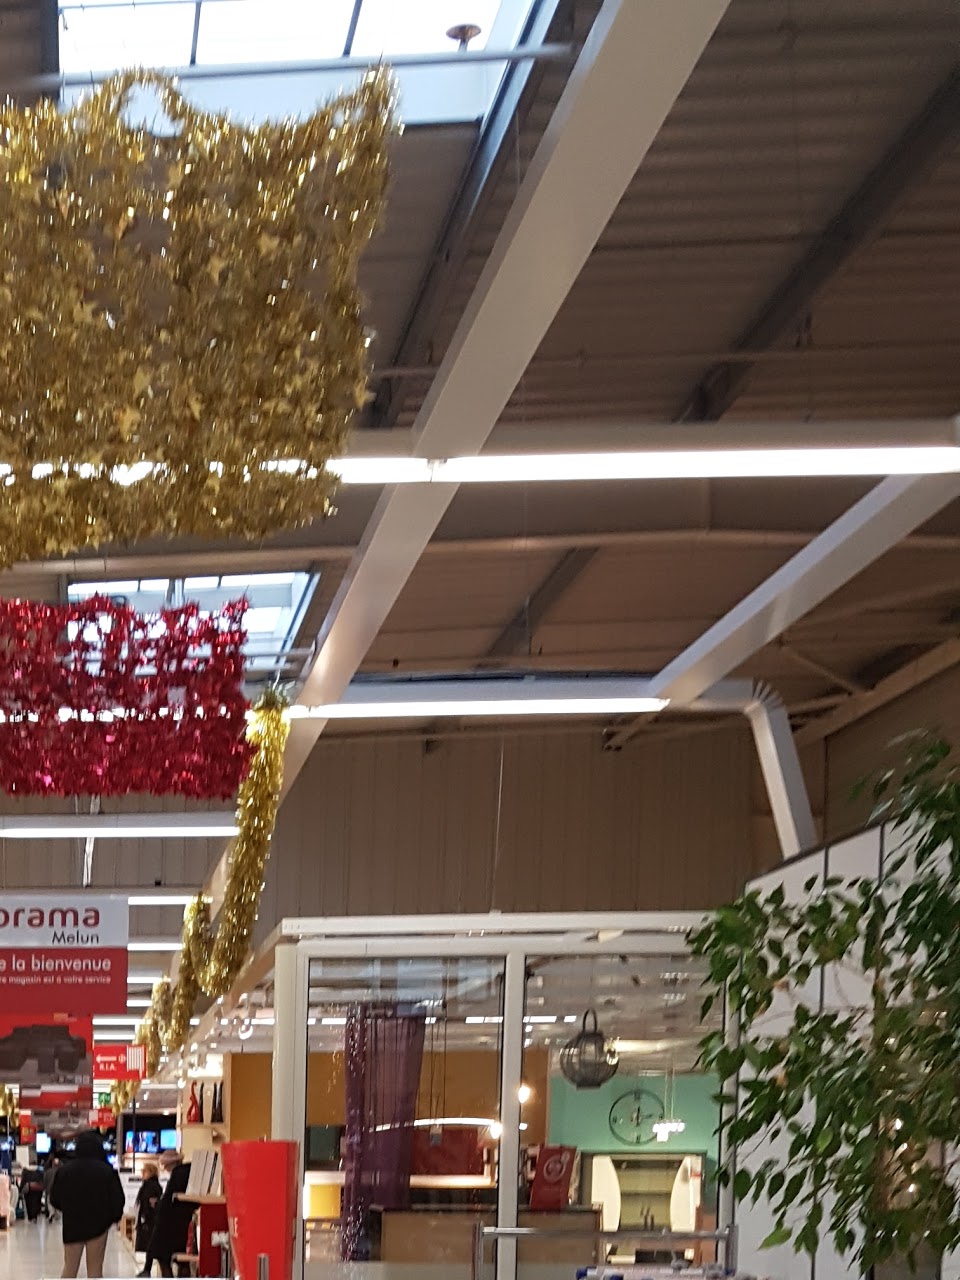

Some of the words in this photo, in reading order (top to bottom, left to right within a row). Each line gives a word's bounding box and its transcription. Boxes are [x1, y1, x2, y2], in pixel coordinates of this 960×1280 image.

[52, 930, 99, 944] Melun
[12, 954, 26, 971] la
[31, 954, 111, 971] bienvenue
[9, 974, 42, 986] magasin
